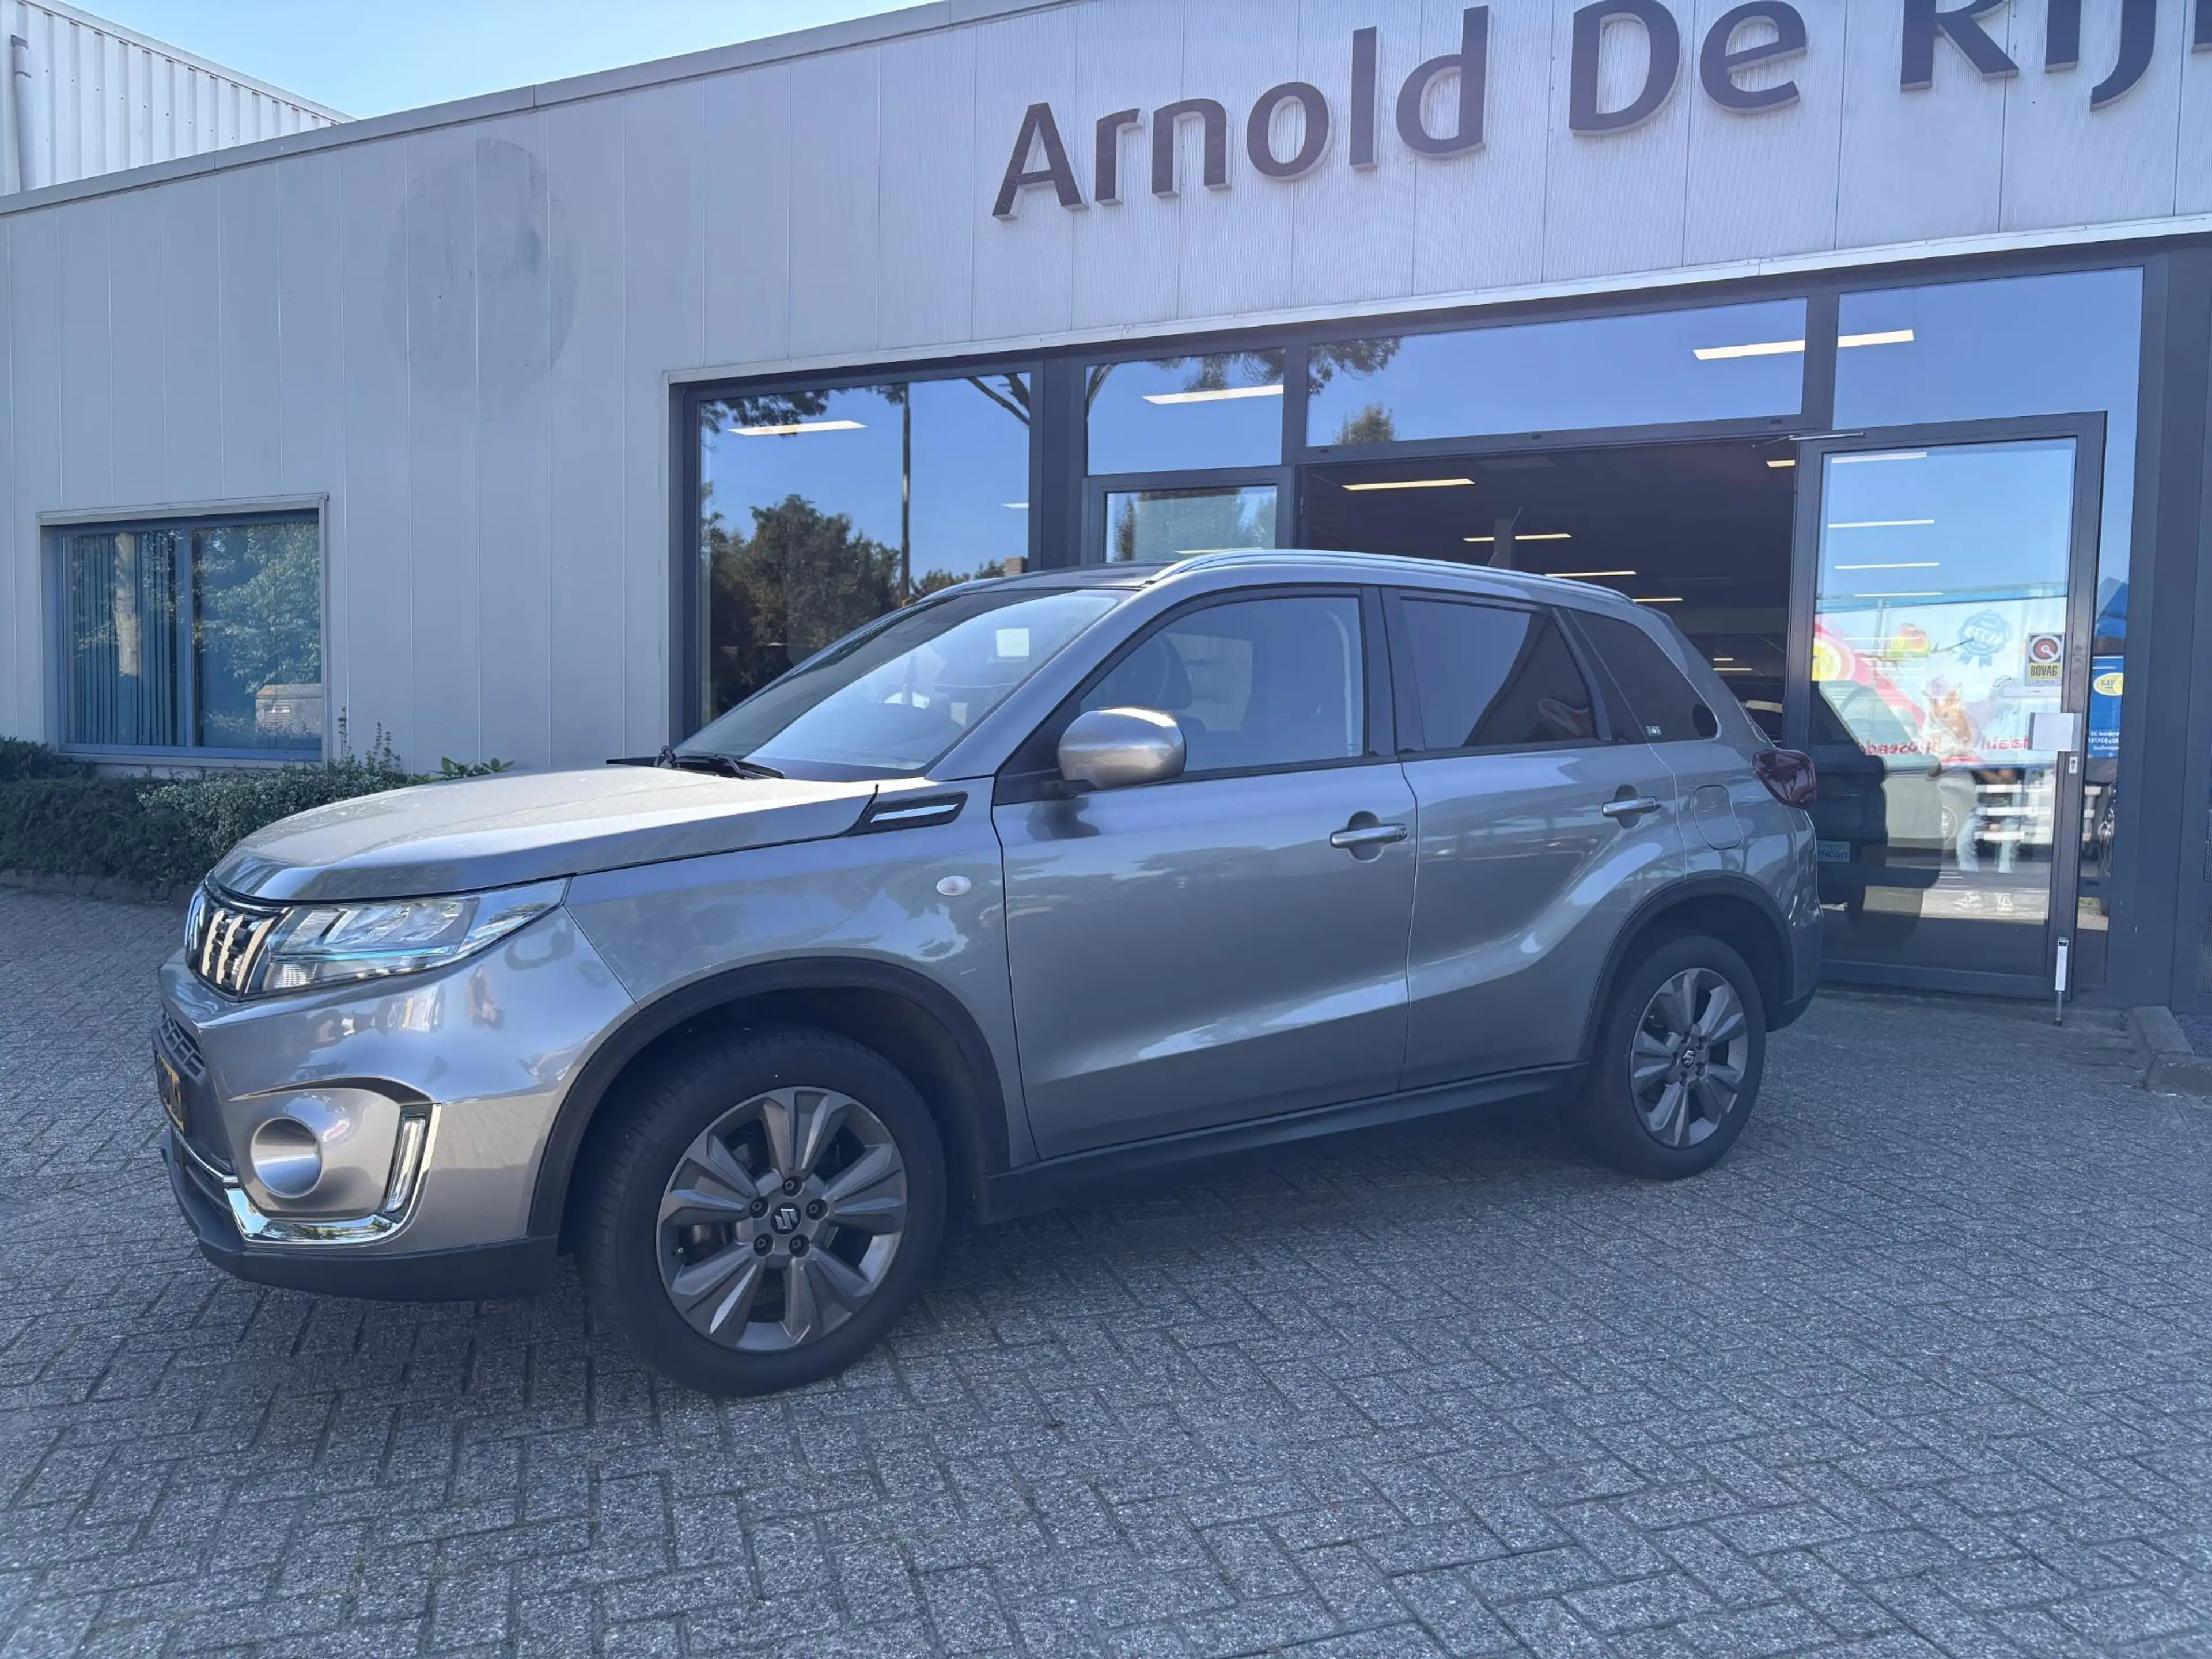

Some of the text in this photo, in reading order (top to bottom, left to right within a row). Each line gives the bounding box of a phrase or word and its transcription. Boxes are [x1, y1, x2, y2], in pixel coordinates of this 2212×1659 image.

[992, 0, 2212, 220] Arnold De Rj
[2031, 665, 2058, 677] BOVAG
